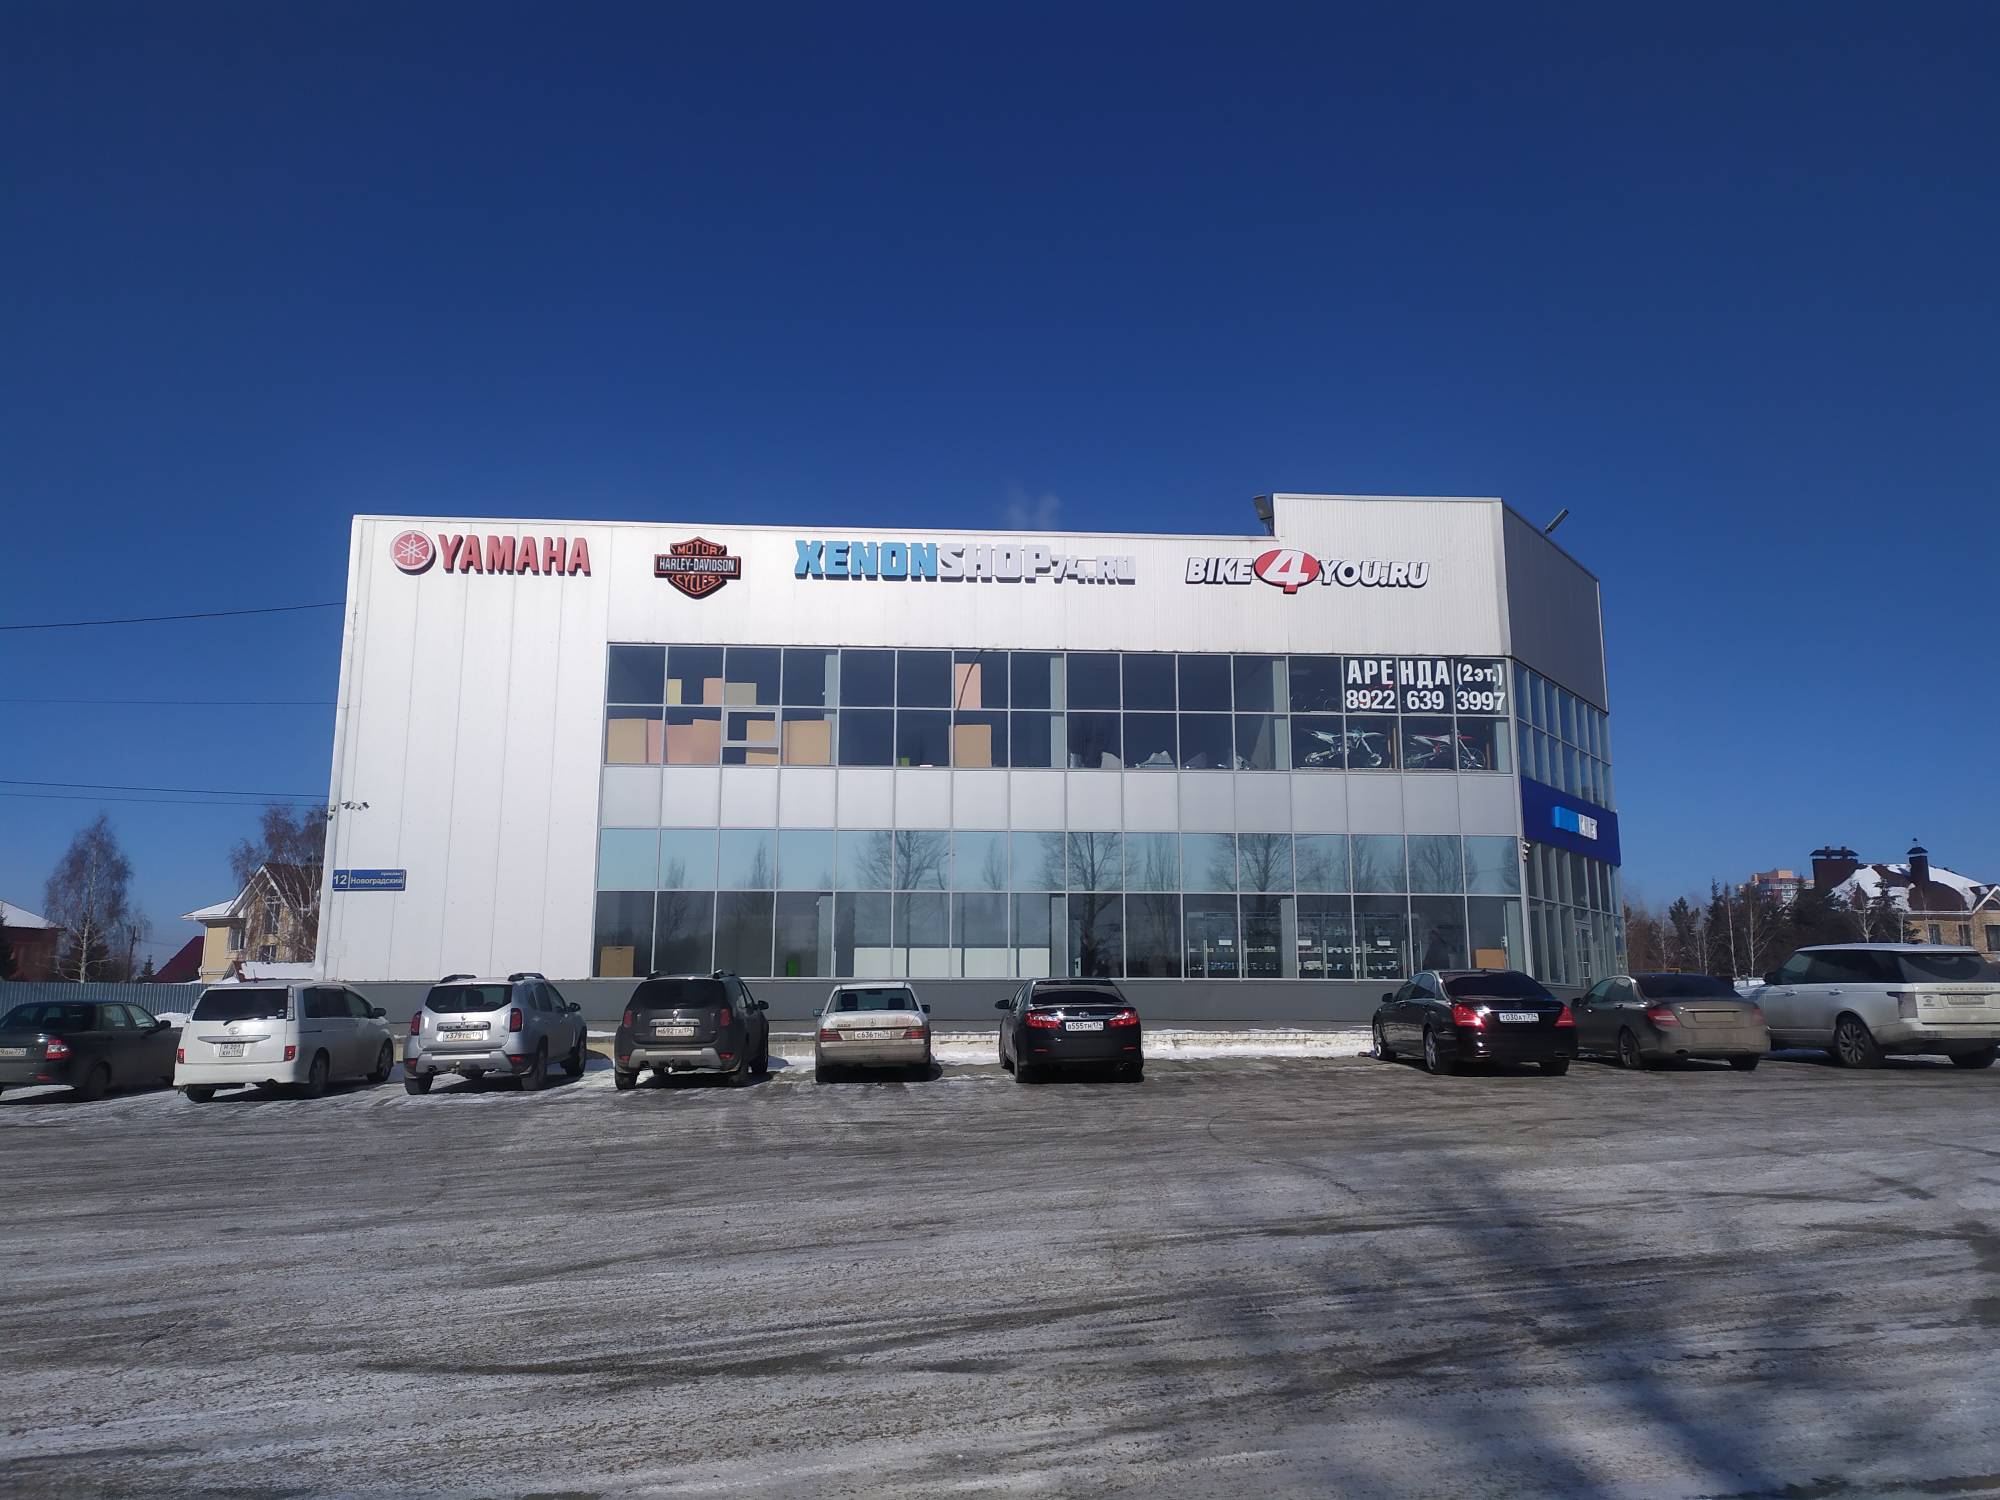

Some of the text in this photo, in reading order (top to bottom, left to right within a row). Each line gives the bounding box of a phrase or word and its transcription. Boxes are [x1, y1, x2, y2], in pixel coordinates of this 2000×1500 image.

[438, 534, 591, 577] YAMAHA
[677, 541, 717, 555] MOTOR
[659, 558, 735, 572] HARLEY-DAVIDSON
[675, 575, 717, 592] CYCLES
[1346, 690, 1506, 711] 8922 639 3997
[334, 874, 347, 886] 12
